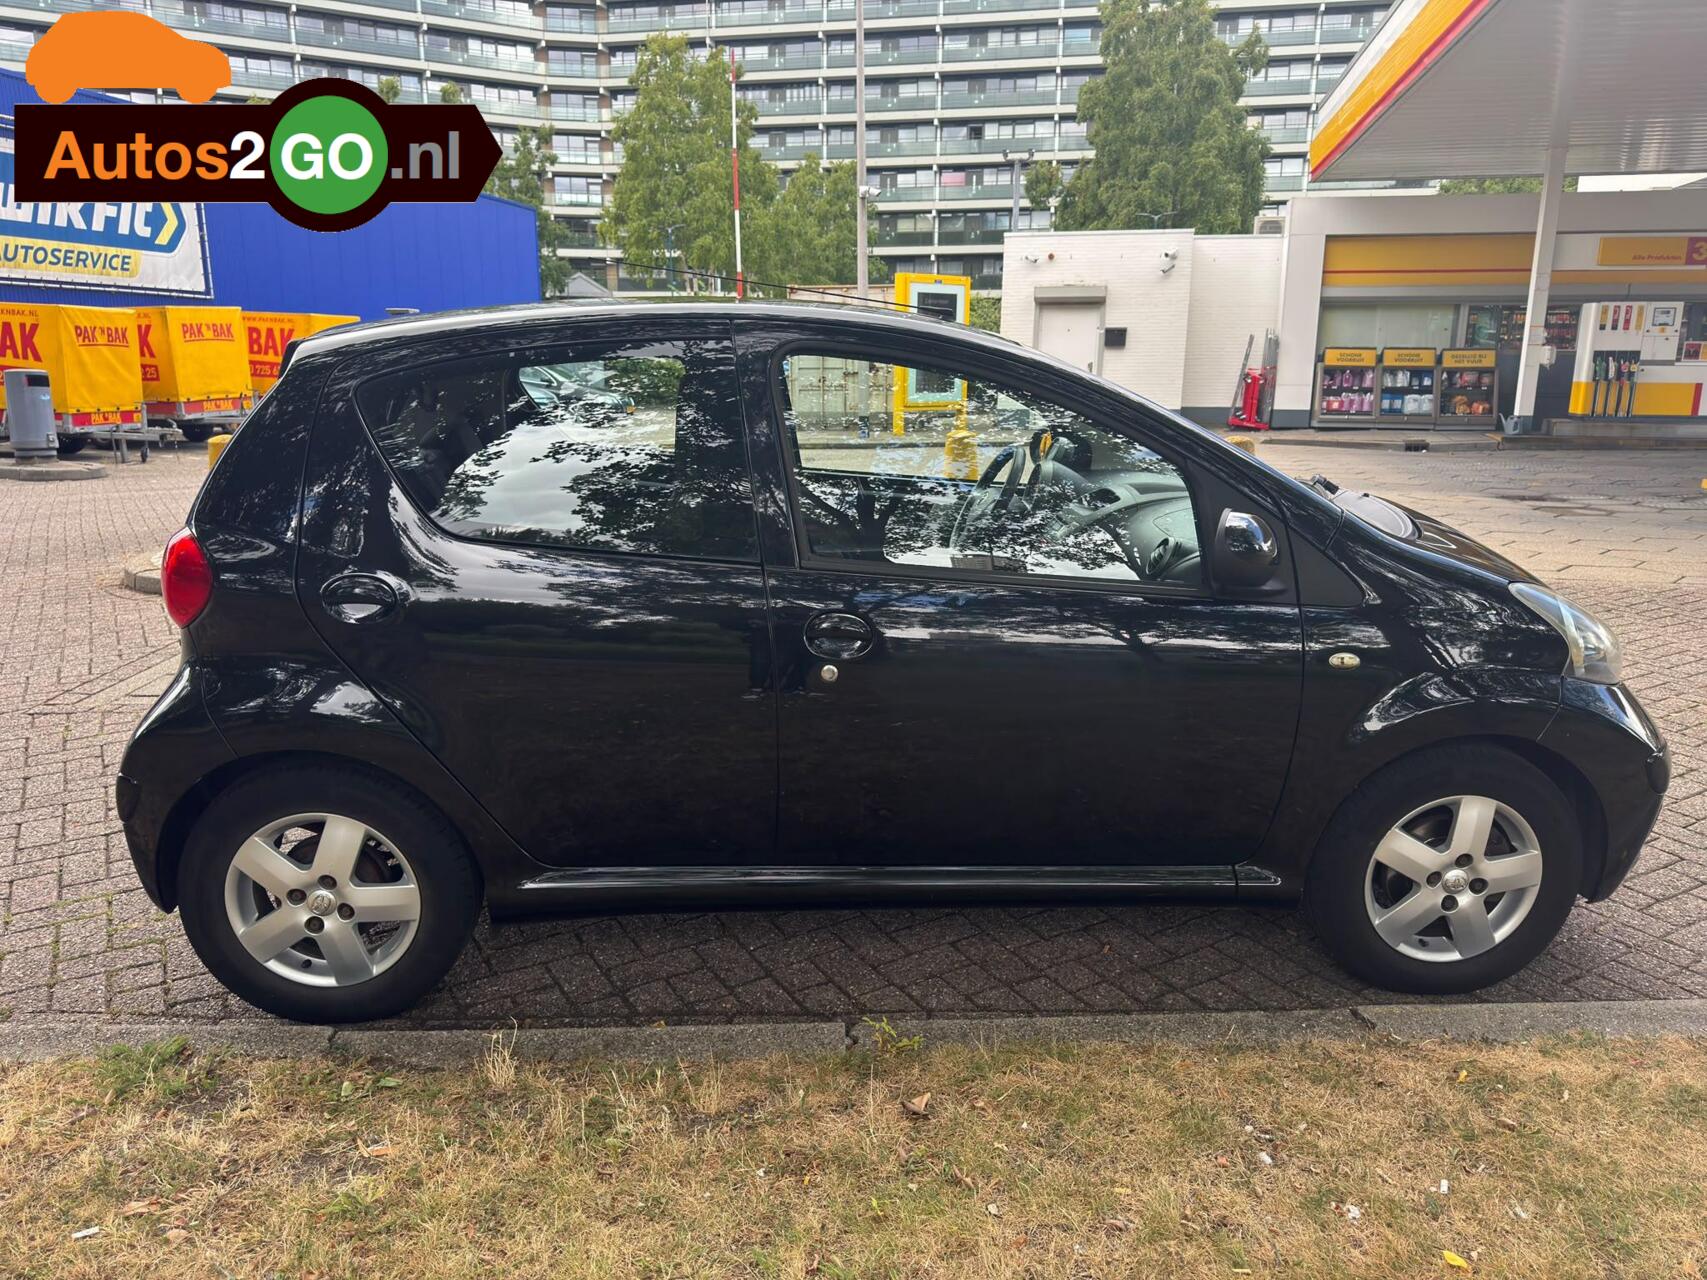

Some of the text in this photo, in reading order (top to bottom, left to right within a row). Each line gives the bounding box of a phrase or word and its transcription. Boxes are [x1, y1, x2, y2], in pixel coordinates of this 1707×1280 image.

[0, 243, 132, 272] UTOSERVICE
[75, 325, 98, 343] PAK
[107, 326, 128, 344] BAK
[181, 323, 204, 339] PAK
[212, 323, 234, 338] BAK
